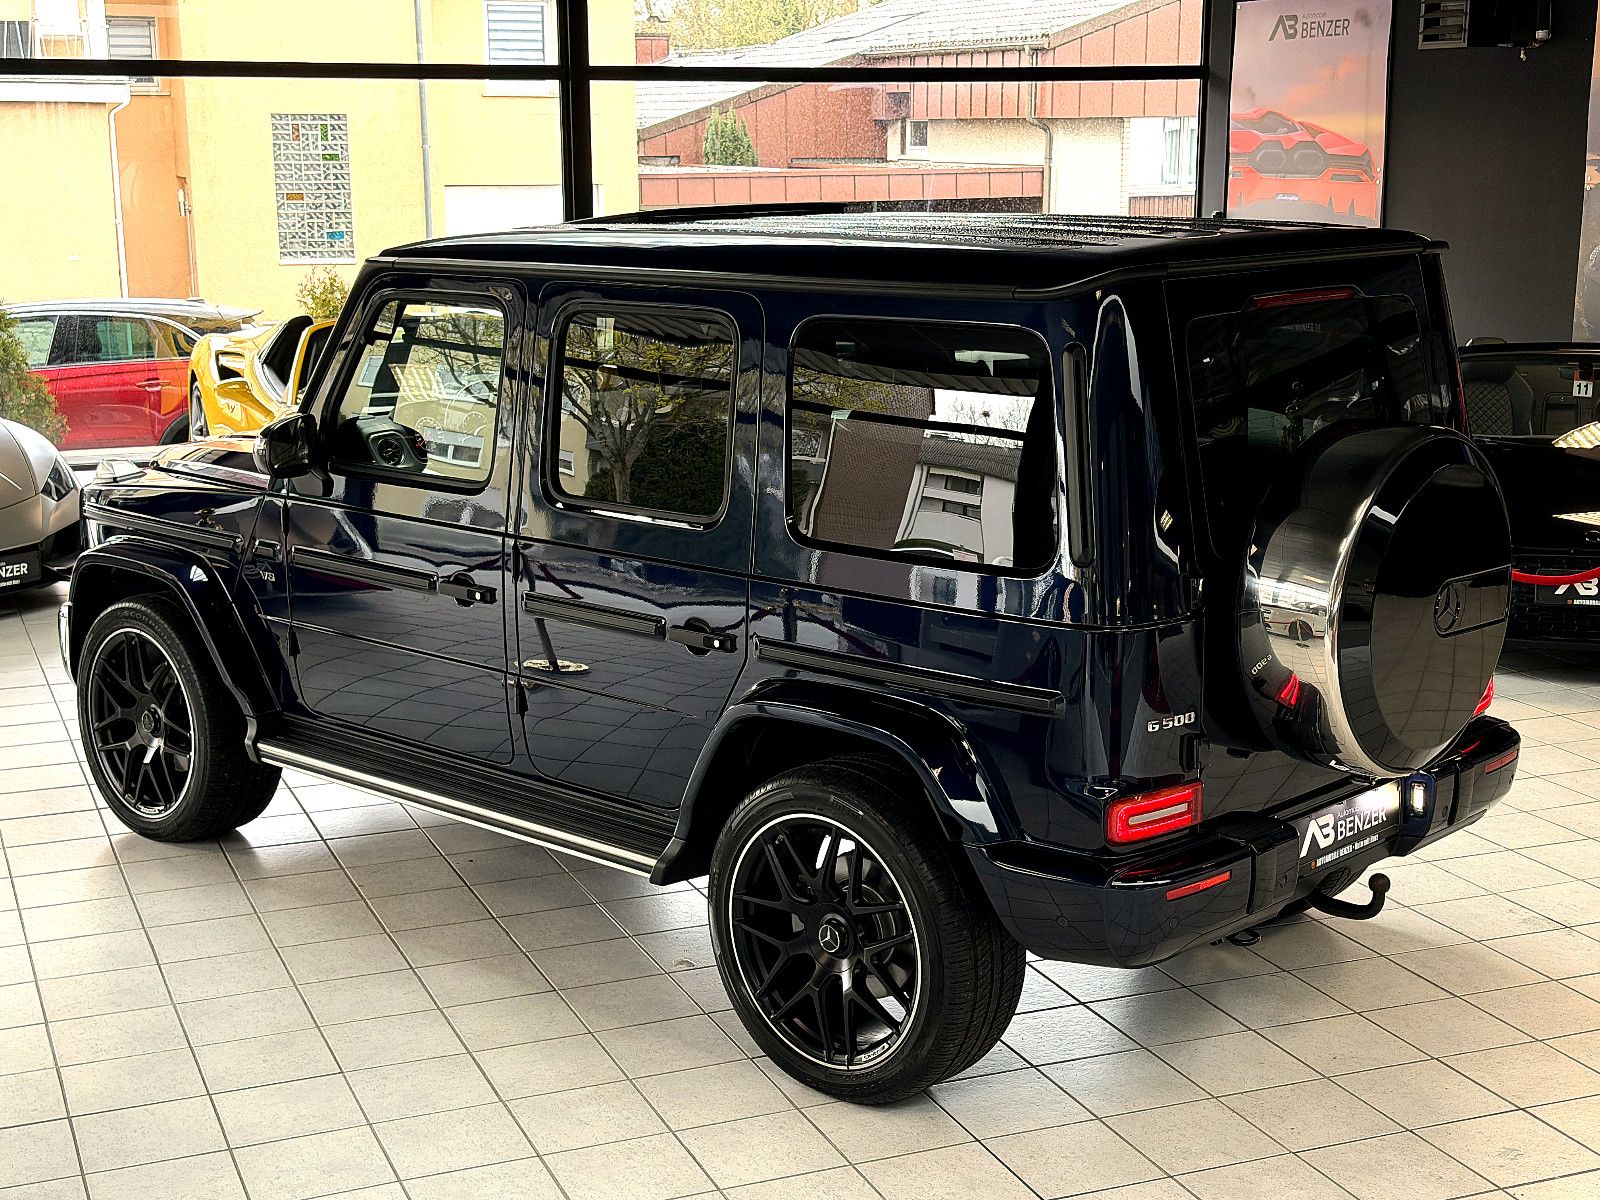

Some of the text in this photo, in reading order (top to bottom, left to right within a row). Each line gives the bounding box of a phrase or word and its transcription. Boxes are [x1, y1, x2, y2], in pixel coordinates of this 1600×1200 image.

[1301, 19, 1350, 38] BENZER
[1577, 382, 1589, 396] 11
[1147, 711, 1196, 732] G 500
[1337, 808, 1387, 841] BENZER
